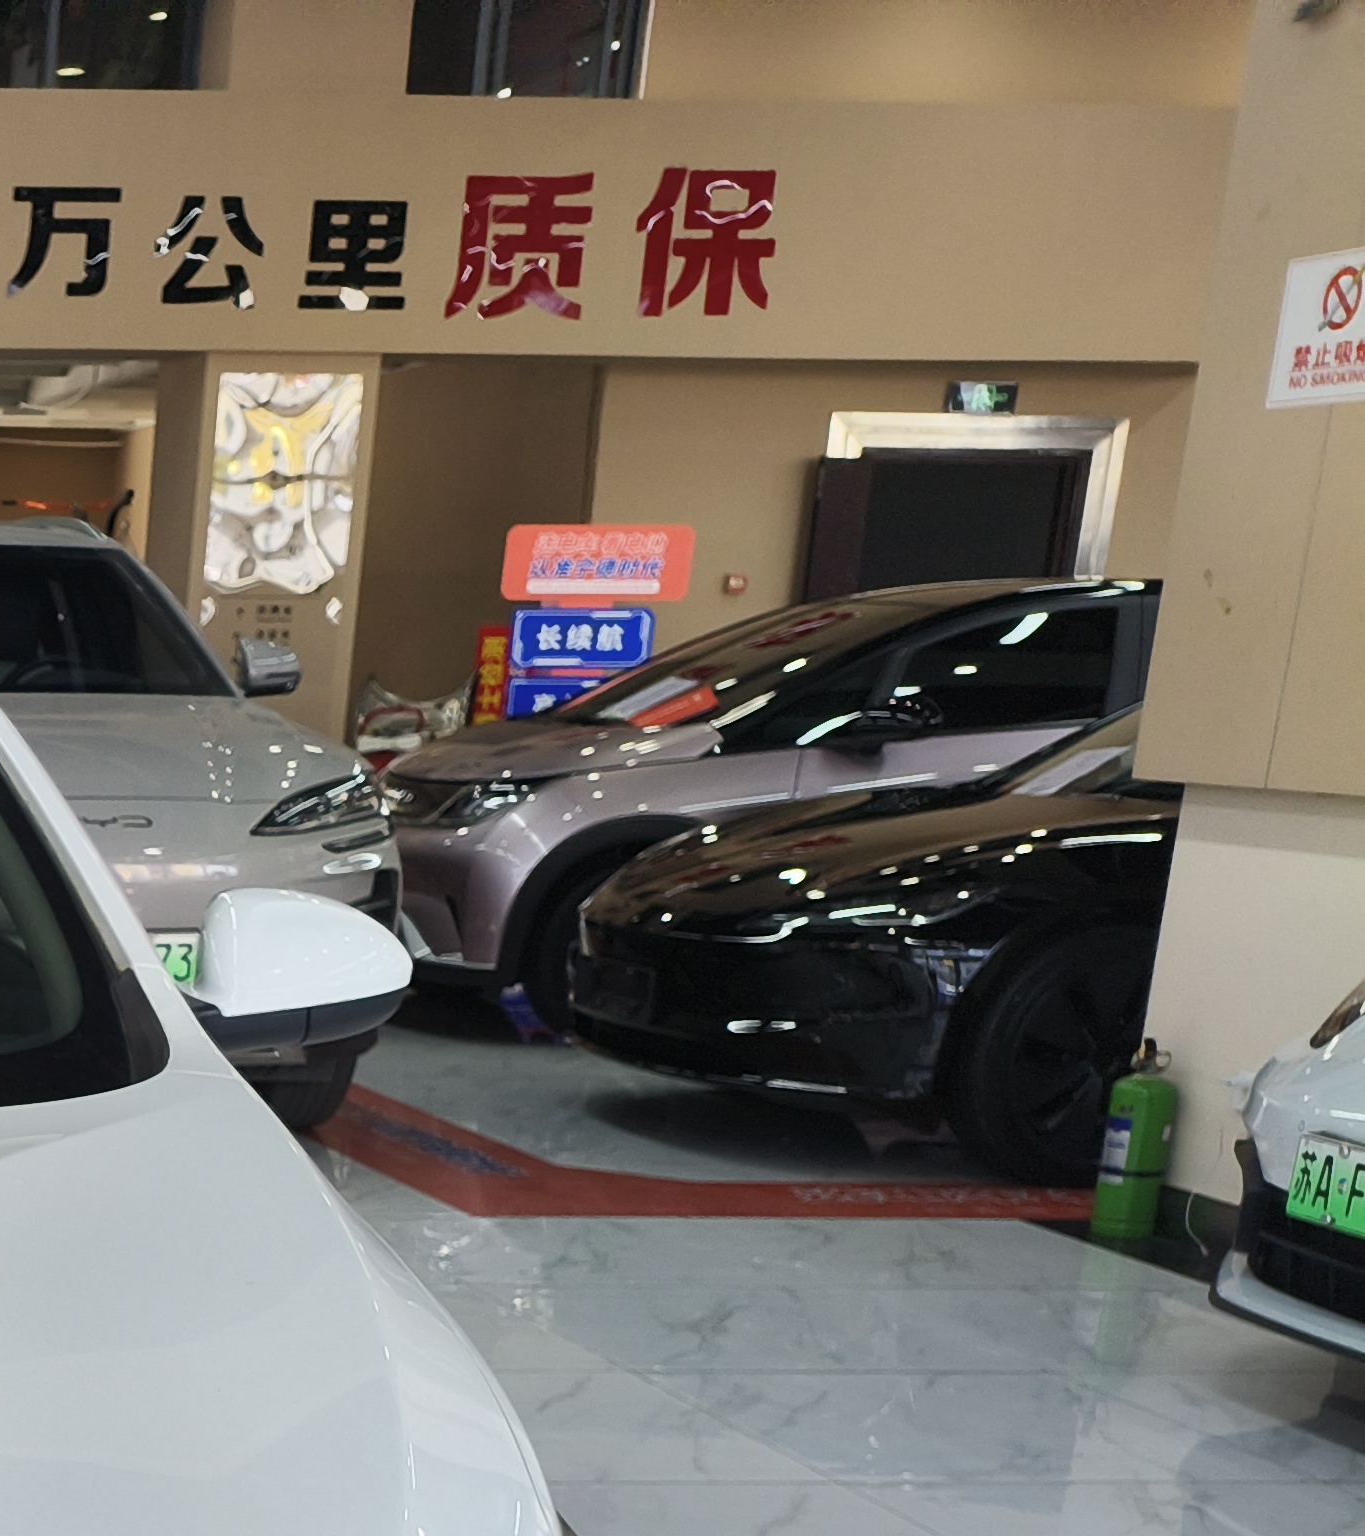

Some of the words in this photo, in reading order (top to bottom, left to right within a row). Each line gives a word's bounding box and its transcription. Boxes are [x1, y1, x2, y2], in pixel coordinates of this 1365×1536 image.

[1289, 373, 1307, 390] NO
[536, 623, 625, 652] 长续航
